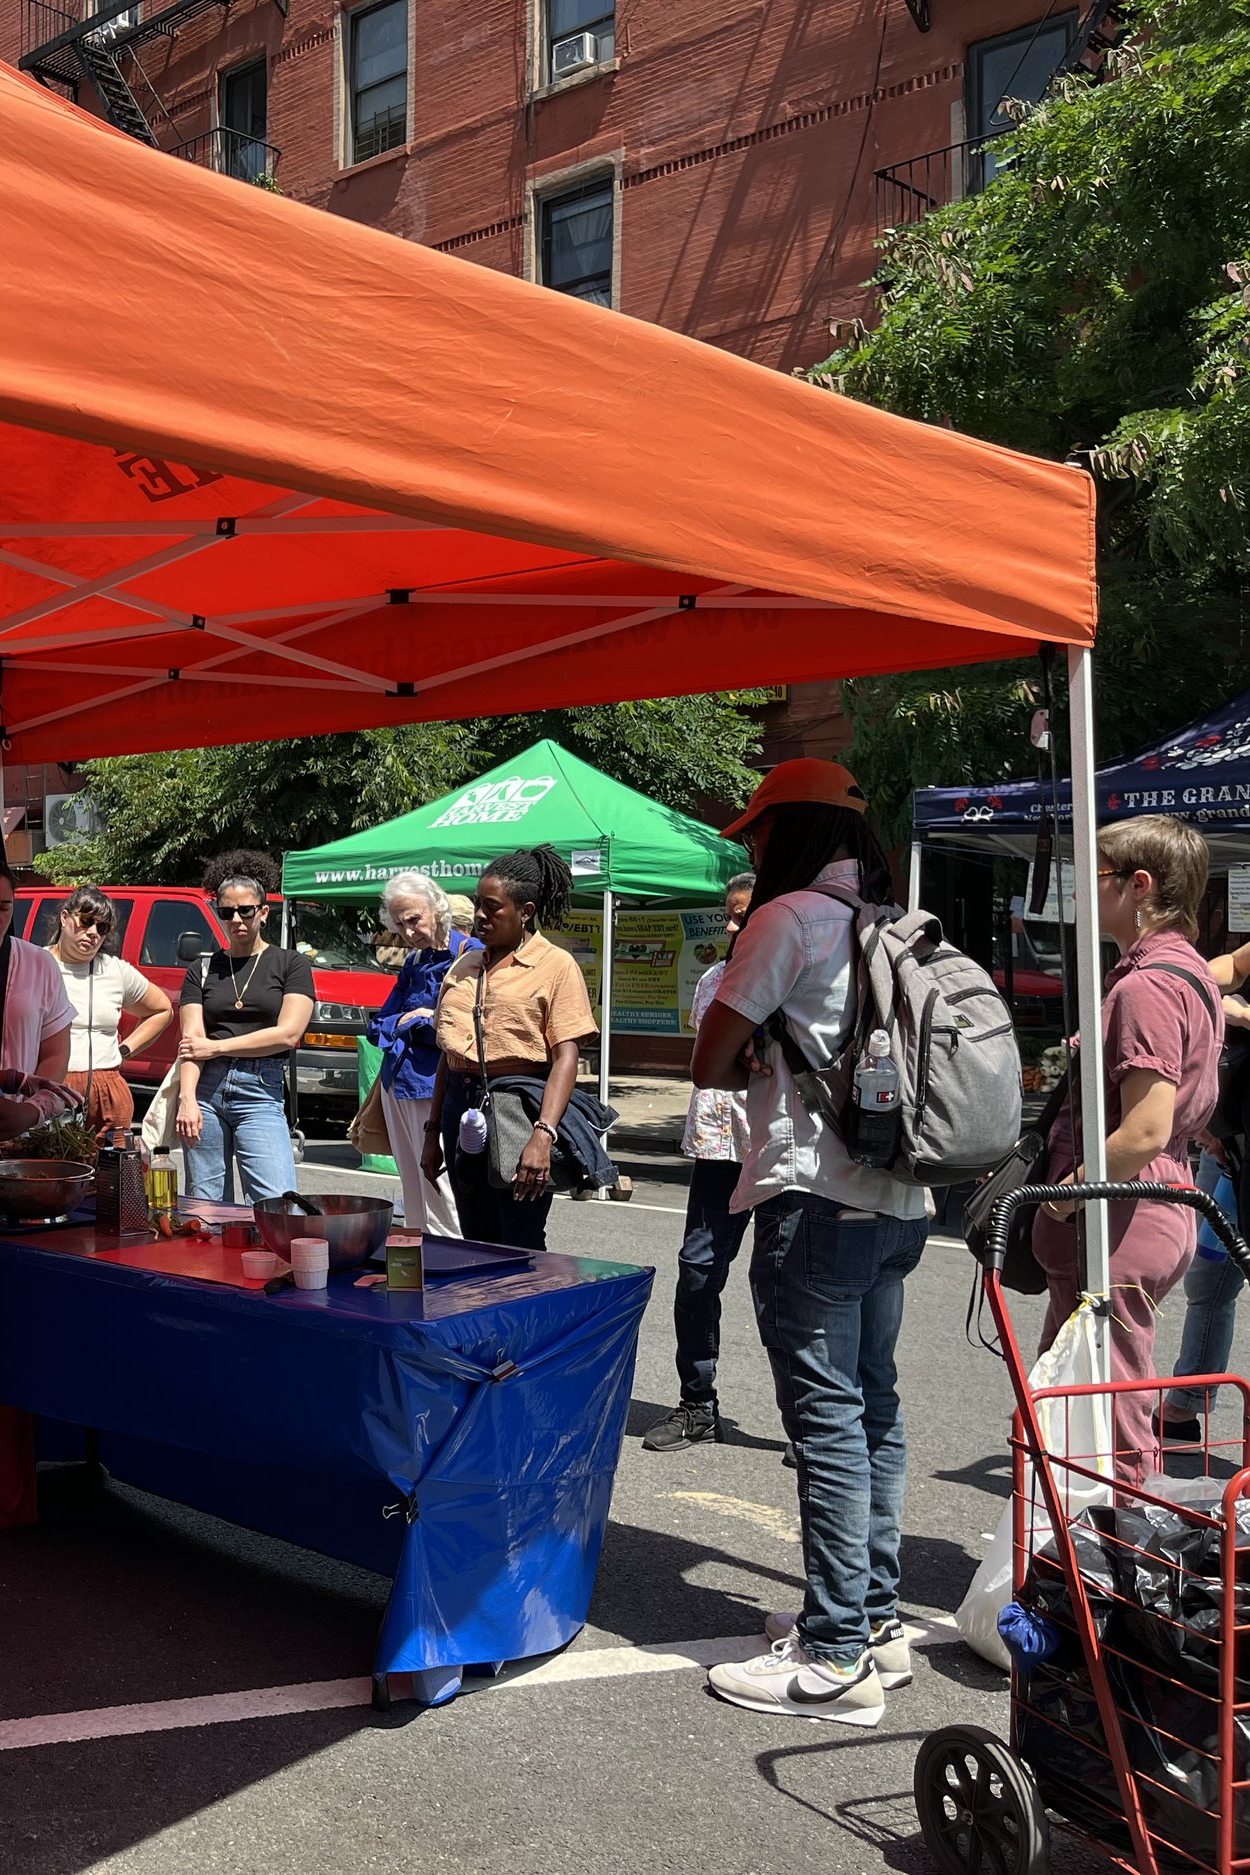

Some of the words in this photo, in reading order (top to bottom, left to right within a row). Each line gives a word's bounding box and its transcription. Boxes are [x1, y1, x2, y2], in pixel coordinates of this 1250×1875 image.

[1124, 789, 1176, 809] THE
[426, 809, 529, 829] HOME
[684, 914, 705, 925] USE
[706, 913, 729, 923] YOU
